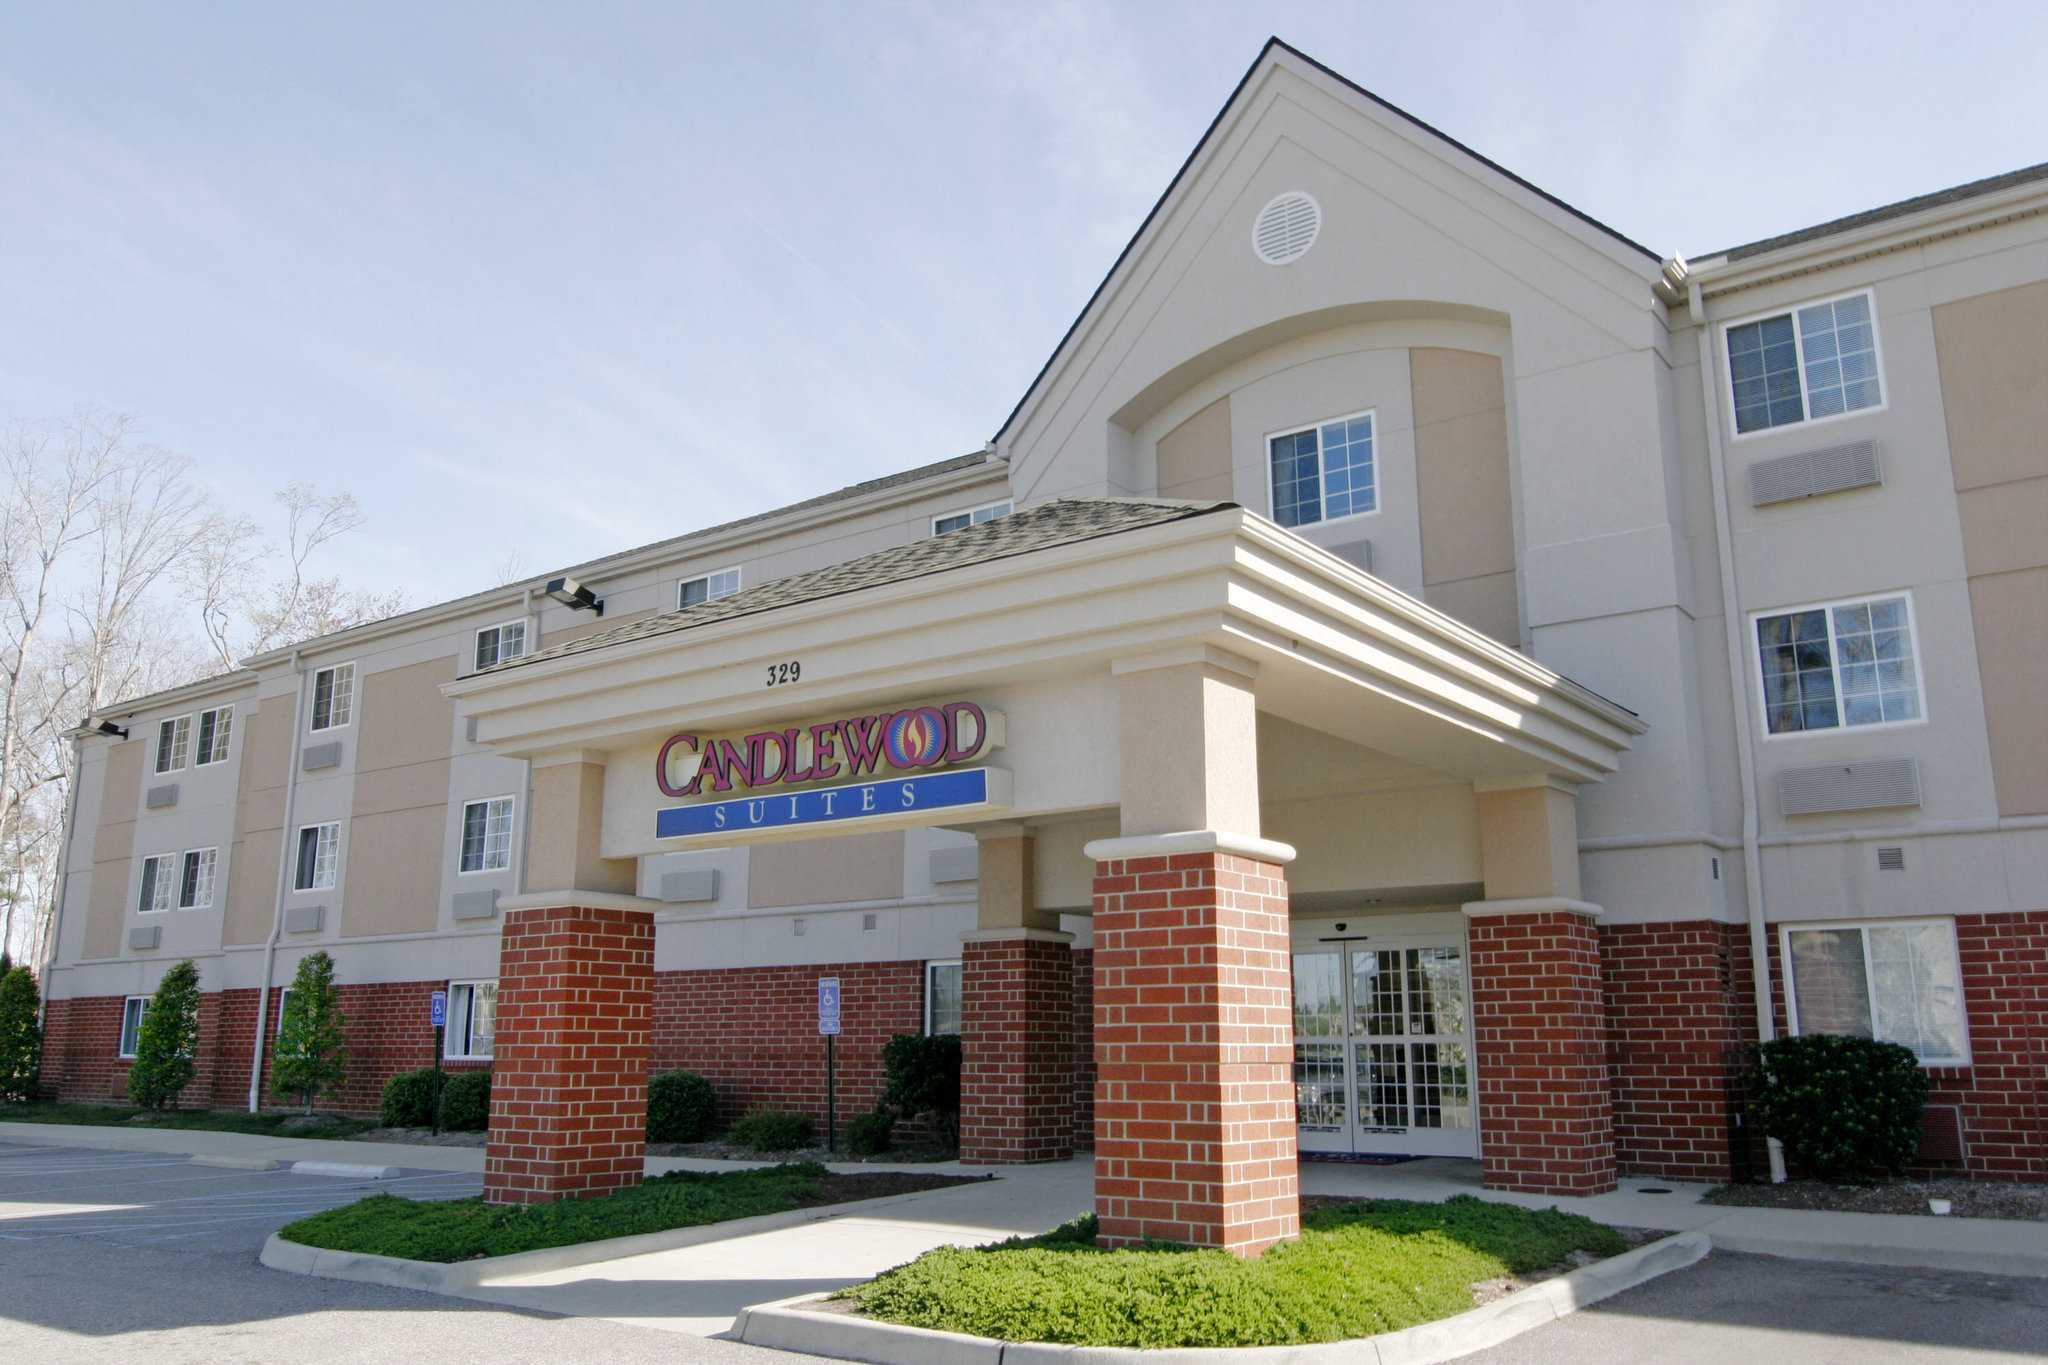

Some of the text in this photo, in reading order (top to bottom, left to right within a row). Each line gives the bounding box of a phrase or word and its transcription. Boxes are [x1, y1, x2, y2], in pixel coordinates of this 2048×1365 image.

[767, 661, 800, 686] 329
[656, 702, 987, 798] CANDLEWOOD
[714, 783, 915, 828] SUITES
